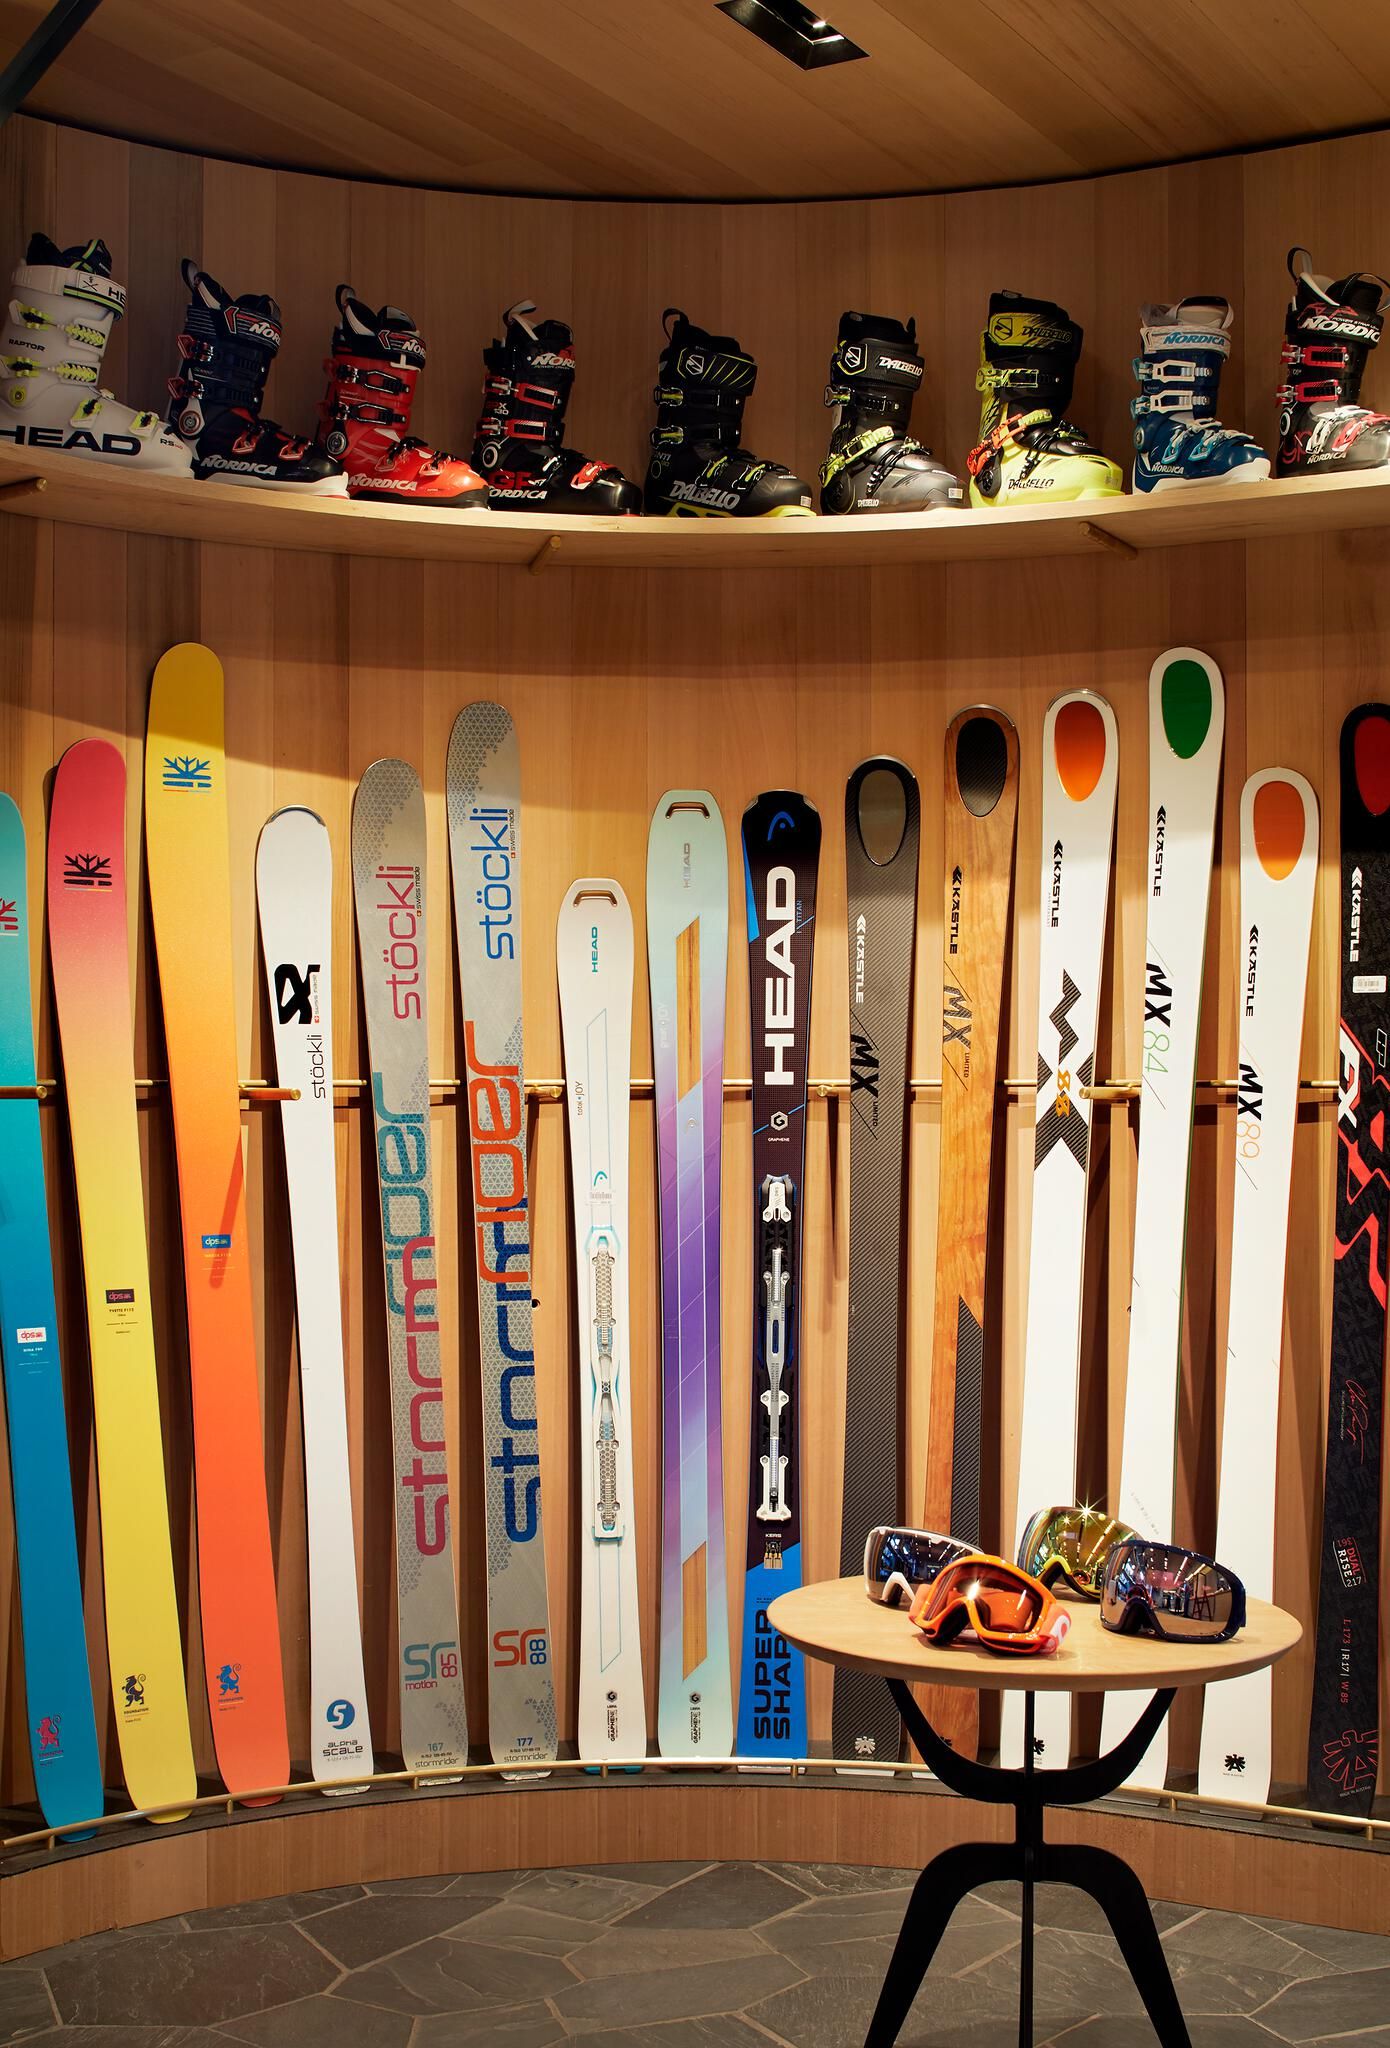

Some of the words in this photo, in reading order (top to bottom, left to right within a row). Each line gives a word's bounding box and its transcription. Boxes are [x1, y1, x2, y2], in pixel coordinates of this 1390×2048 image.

[1021, 325, 1073, 343] DALBELLO
[1163, 331, 1225, 347] NORDICA
[8, 338, 46, 352] RAPTOR
[878, 356, 923, 377] DALBELLO
[0, 425, 142, 456] HEAD
[201, 454, 278, 476] NORDICA
[1307, 449, 1347, 464] NORDICA
[1151, 461, 1184, 474] NORDICA
[349, 472, 417, 491] NORDICA
[669, 480, 741, 509] DALBELLO
[857, 498, 880, 507] DALBELLO
[683, 843, 691, 888] HEAD
[591, 926, 599, 973] HEAD
[764, 866, 796, 1086] HEAD
[962, 1052, 970, 1079] LIMITED
[575, 1081, 585, 1096] JOY
[871, 1101, 879, 1128] LIMITED
[205, 1237, 220, 1247] dps
[109, 1291, 124, 1302] dps
[21, 1331, 36, 1341] dps
[1338, 1549, 1353, 1578] RISE
[1346, 1547, 1361, 1576] DUAL
[1346, 1576, 1362, 1588] 217
[530, 1639, 547, 1665] 88
[440, 1653, 458, 1678] 85
[754, 1608, 772, 1739] SUPER
[1341, 1661, 1349, 1673] 17
[405, 1680, 438, 1691] motion
[774, 1628, 791, 1739] SHAP
[427, 1742, 444, 1752] 167
[516, 1738, 533, 1747] 177
[415, 1757, 460, 1769] stormrider
[504, 1752, 548, 1763] stormrider
